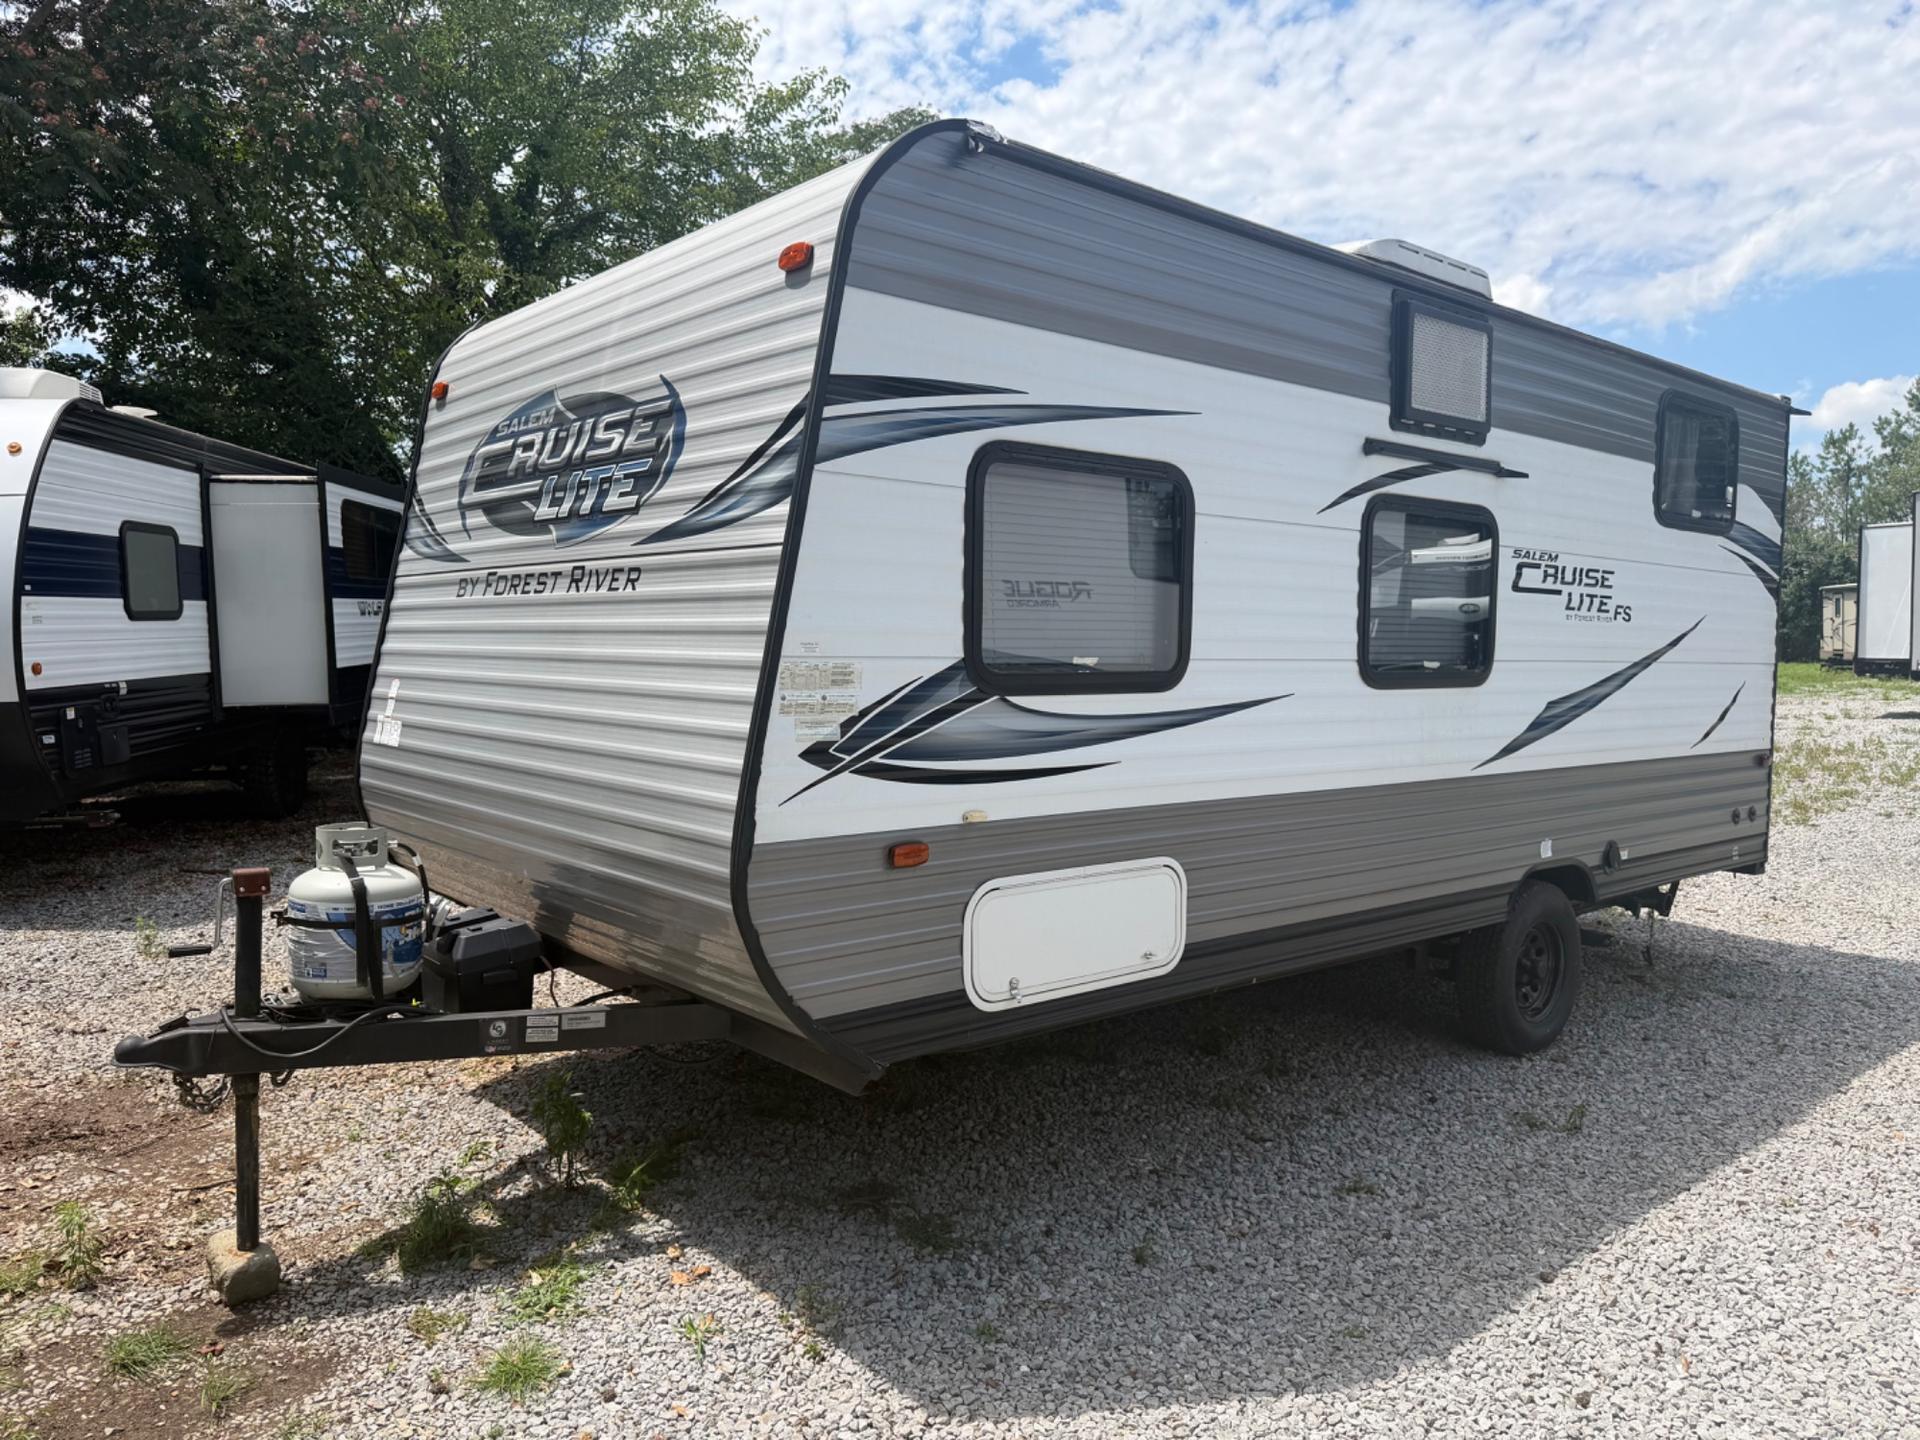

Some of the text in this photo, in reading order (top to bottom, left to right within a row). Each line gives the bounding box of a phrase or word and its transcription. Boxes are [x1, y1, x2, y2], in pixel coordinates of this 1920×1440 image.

[496, 407, 557, 438] SALEM
[461, 398, 673, 506] CRUISE
[532, 457, 654, 522] LITE
[1511, 549, 1559, 563] SALEM
[456, 565, 642, 598] BY FOREST RIVER
[1511, 561, 1615, 596] CRUISE
[1565, 591, 1632, 623] LITE FS
